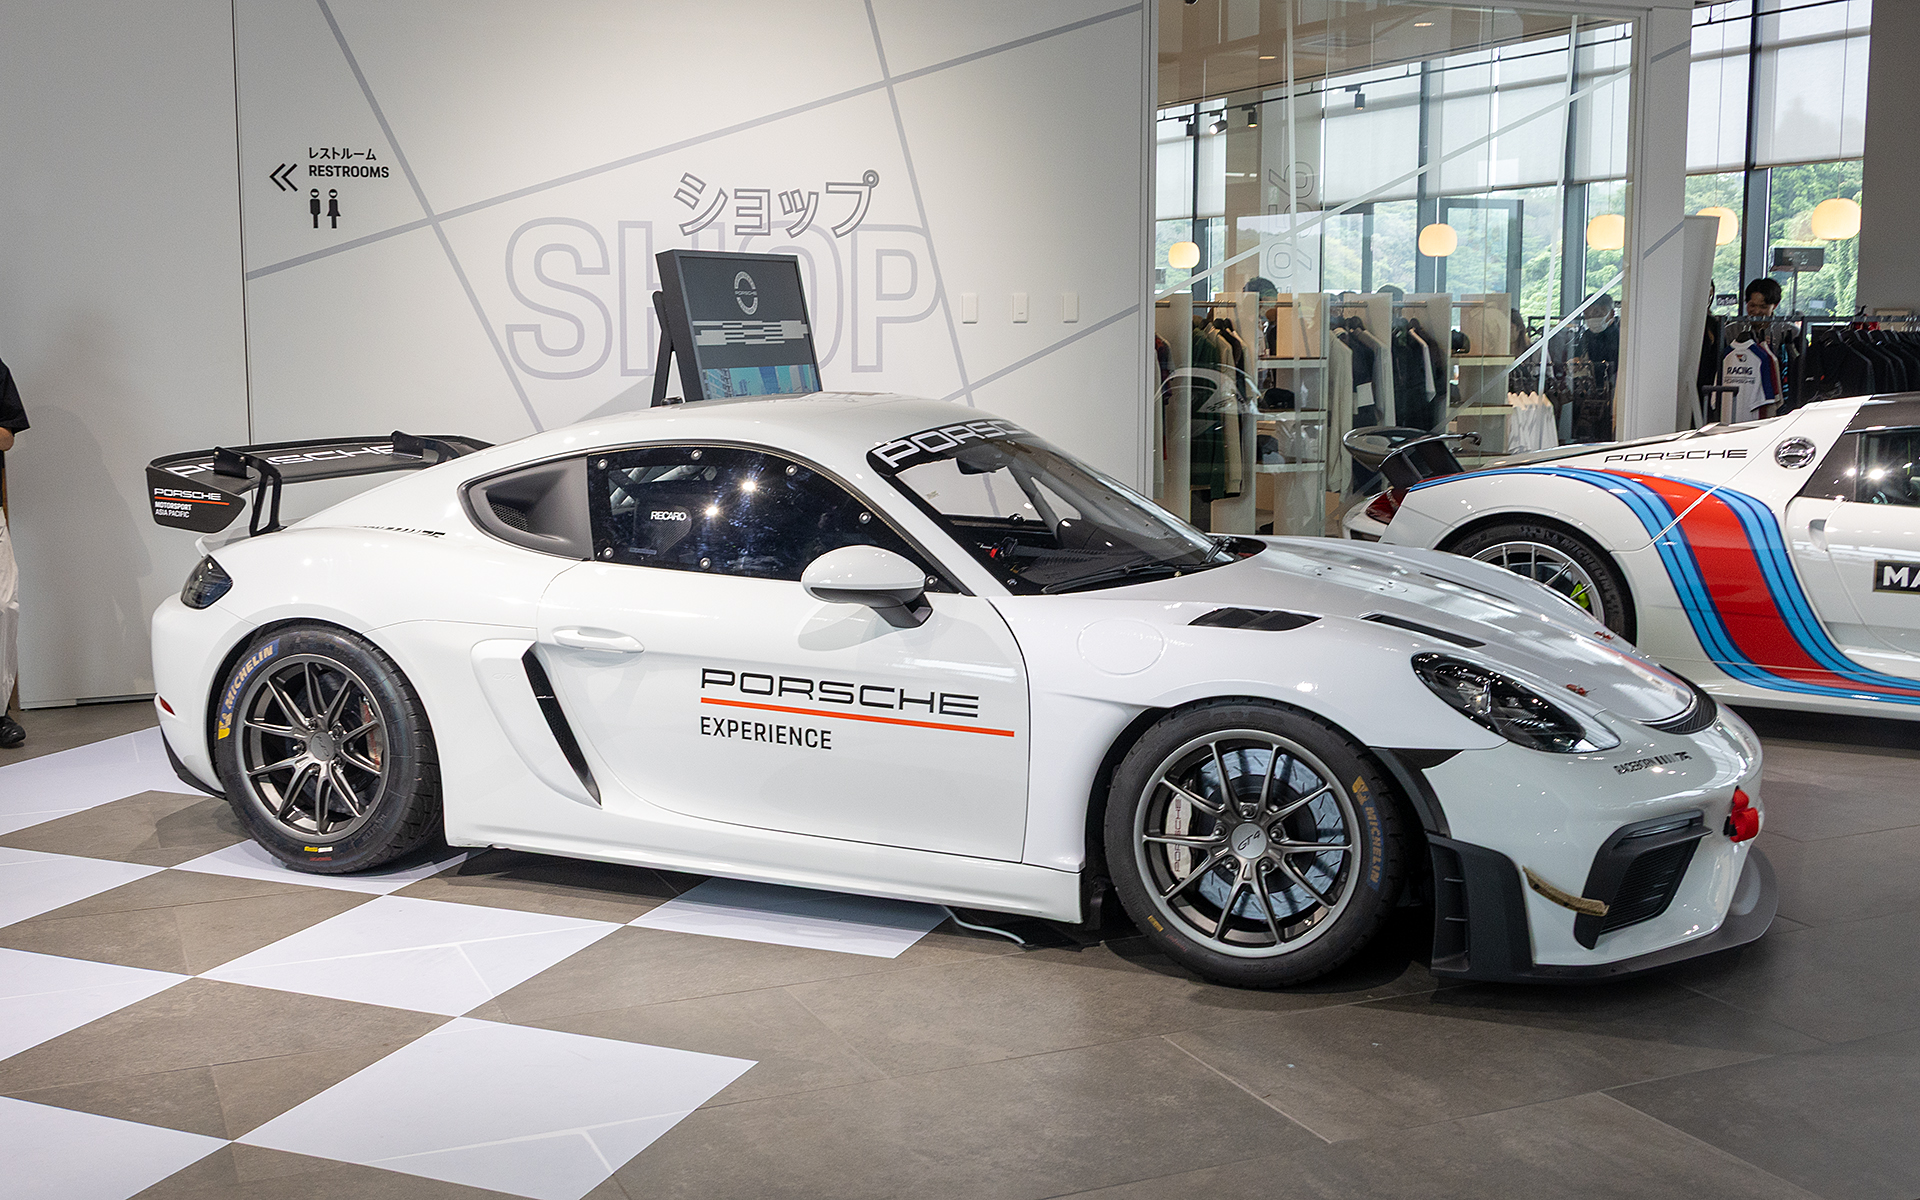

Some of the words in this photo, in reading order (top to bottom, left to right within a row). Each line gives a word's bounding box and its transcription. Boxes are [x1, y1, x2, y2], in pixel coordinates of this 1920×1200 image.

[308, 146, 377, 161] レストルーム
[308, 165, 390, 179] RESTROOMS
[673, 169, 880, 239] ショップ
[164, 444, 395, 478] PSCHE
[1604, 448, 1748, 463] PORSCHE
[154, 488, 222, 501] PORSCHE
[154, 501, 192, 511] MOTORSPORT
[155, 508, 168, 516] ASIA
[168, 509, 190, 518] PACIFIC
[650, 511, 687, 521] RECARO
[225, 644, 273, 710] MICHELIN
[701, 667, 980, 719] PORSCHE
[700, 716, 832, 750] EXPERIENCE
[1237, 830, 1261, 851] GT4
[1364, 806, 1382, 883] MICHELIN
